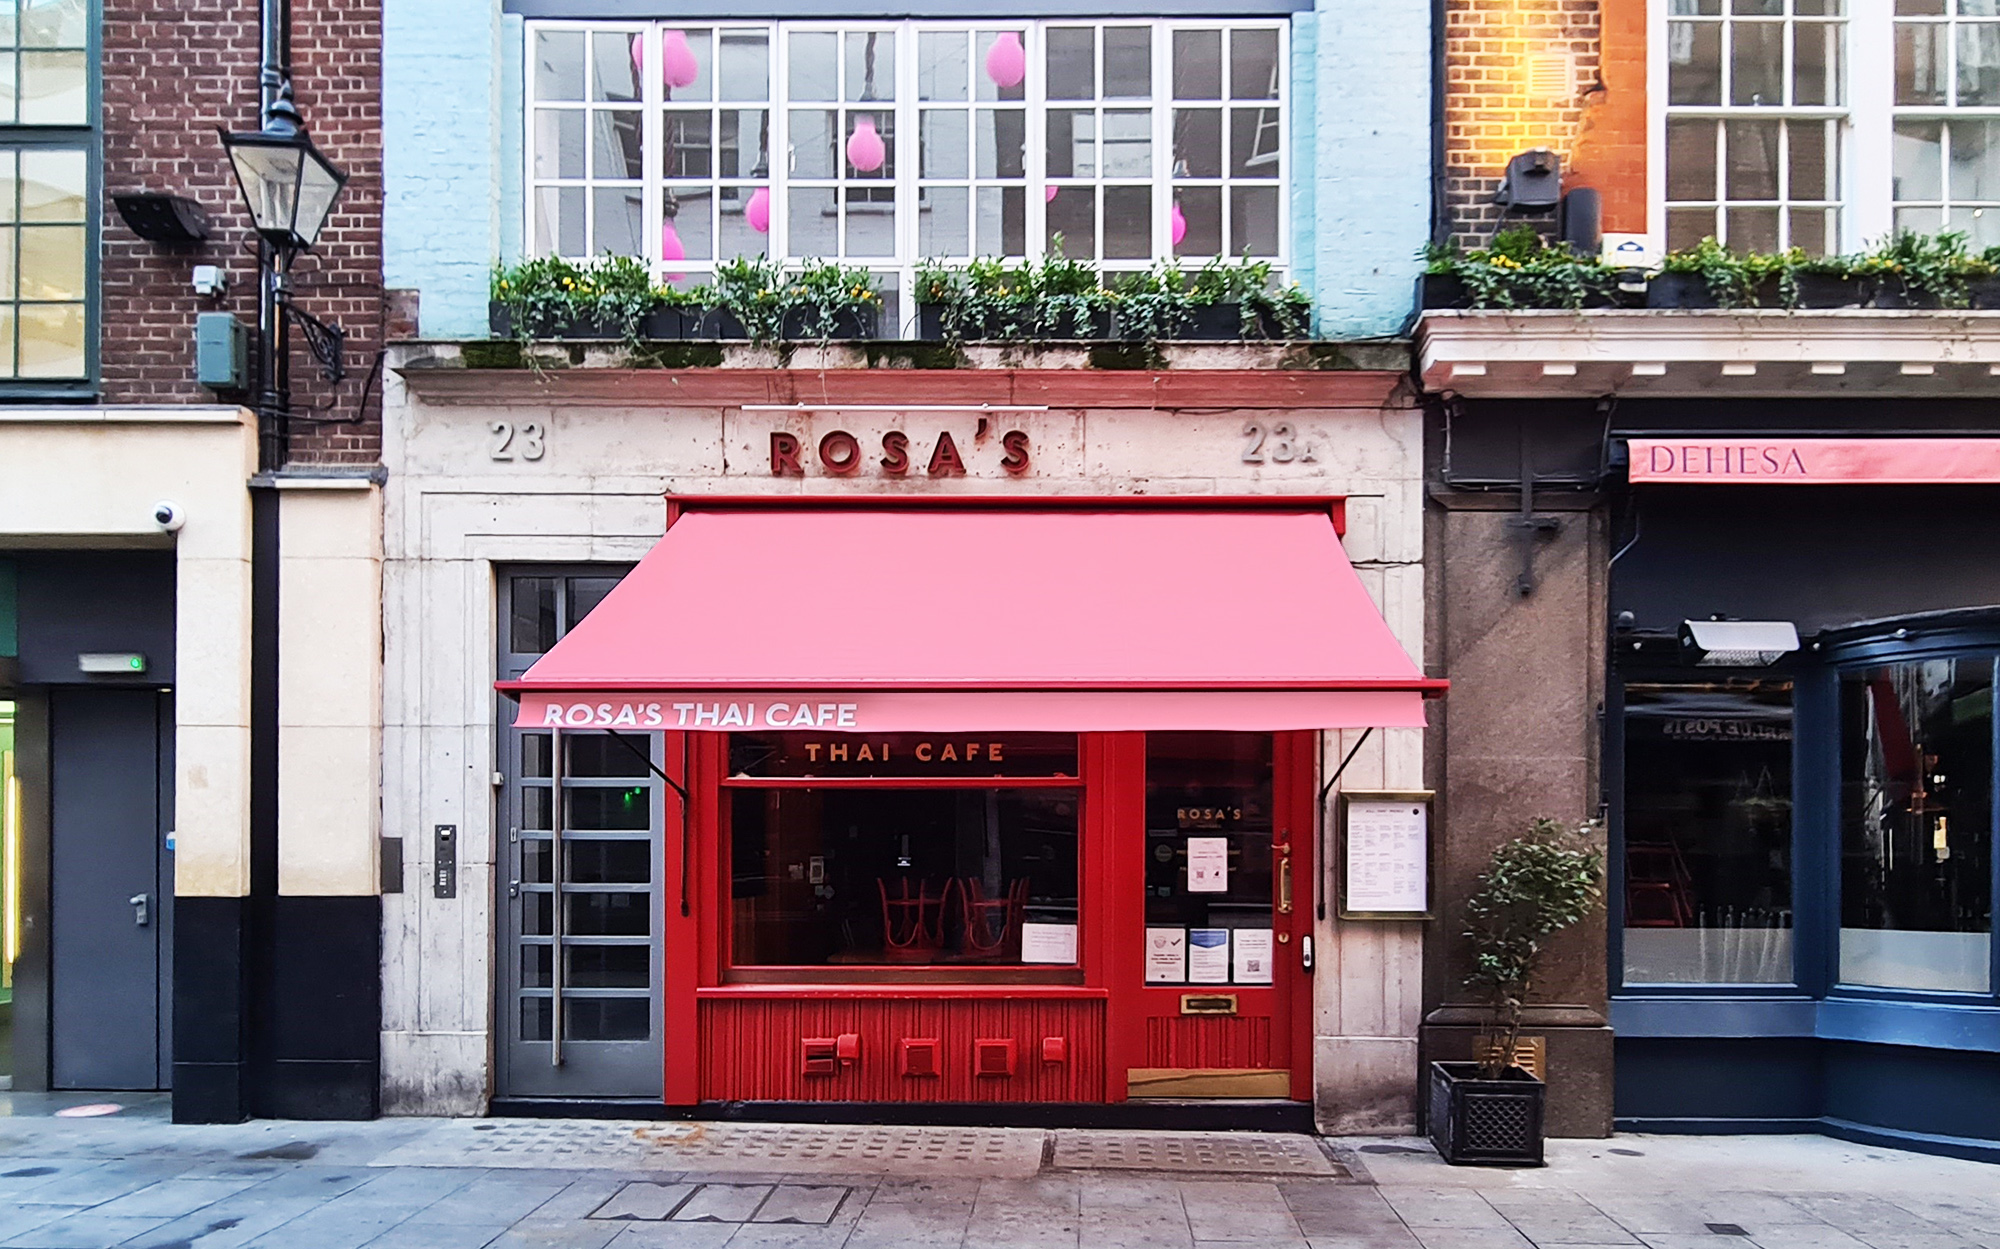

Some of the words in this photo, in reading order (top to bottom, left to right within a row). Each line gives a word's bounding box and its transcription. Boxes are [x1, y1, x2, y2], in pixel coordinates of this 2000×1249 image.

[490, 421, 545, 462] 23
[769, 418, 1030, 475] ROSA'S
[1650, 445, 1807, 475] DEHESA
[542, 703, 663, 728] ROSA'S
[672, 702, 755, 727] THAI
[764, 702, 858, 728] CAFE
[804, 743, 889, 762] THAI
[915, 743, 1003, 761] CAFE
[1177, 806, 1241, 820] ROSA'S
